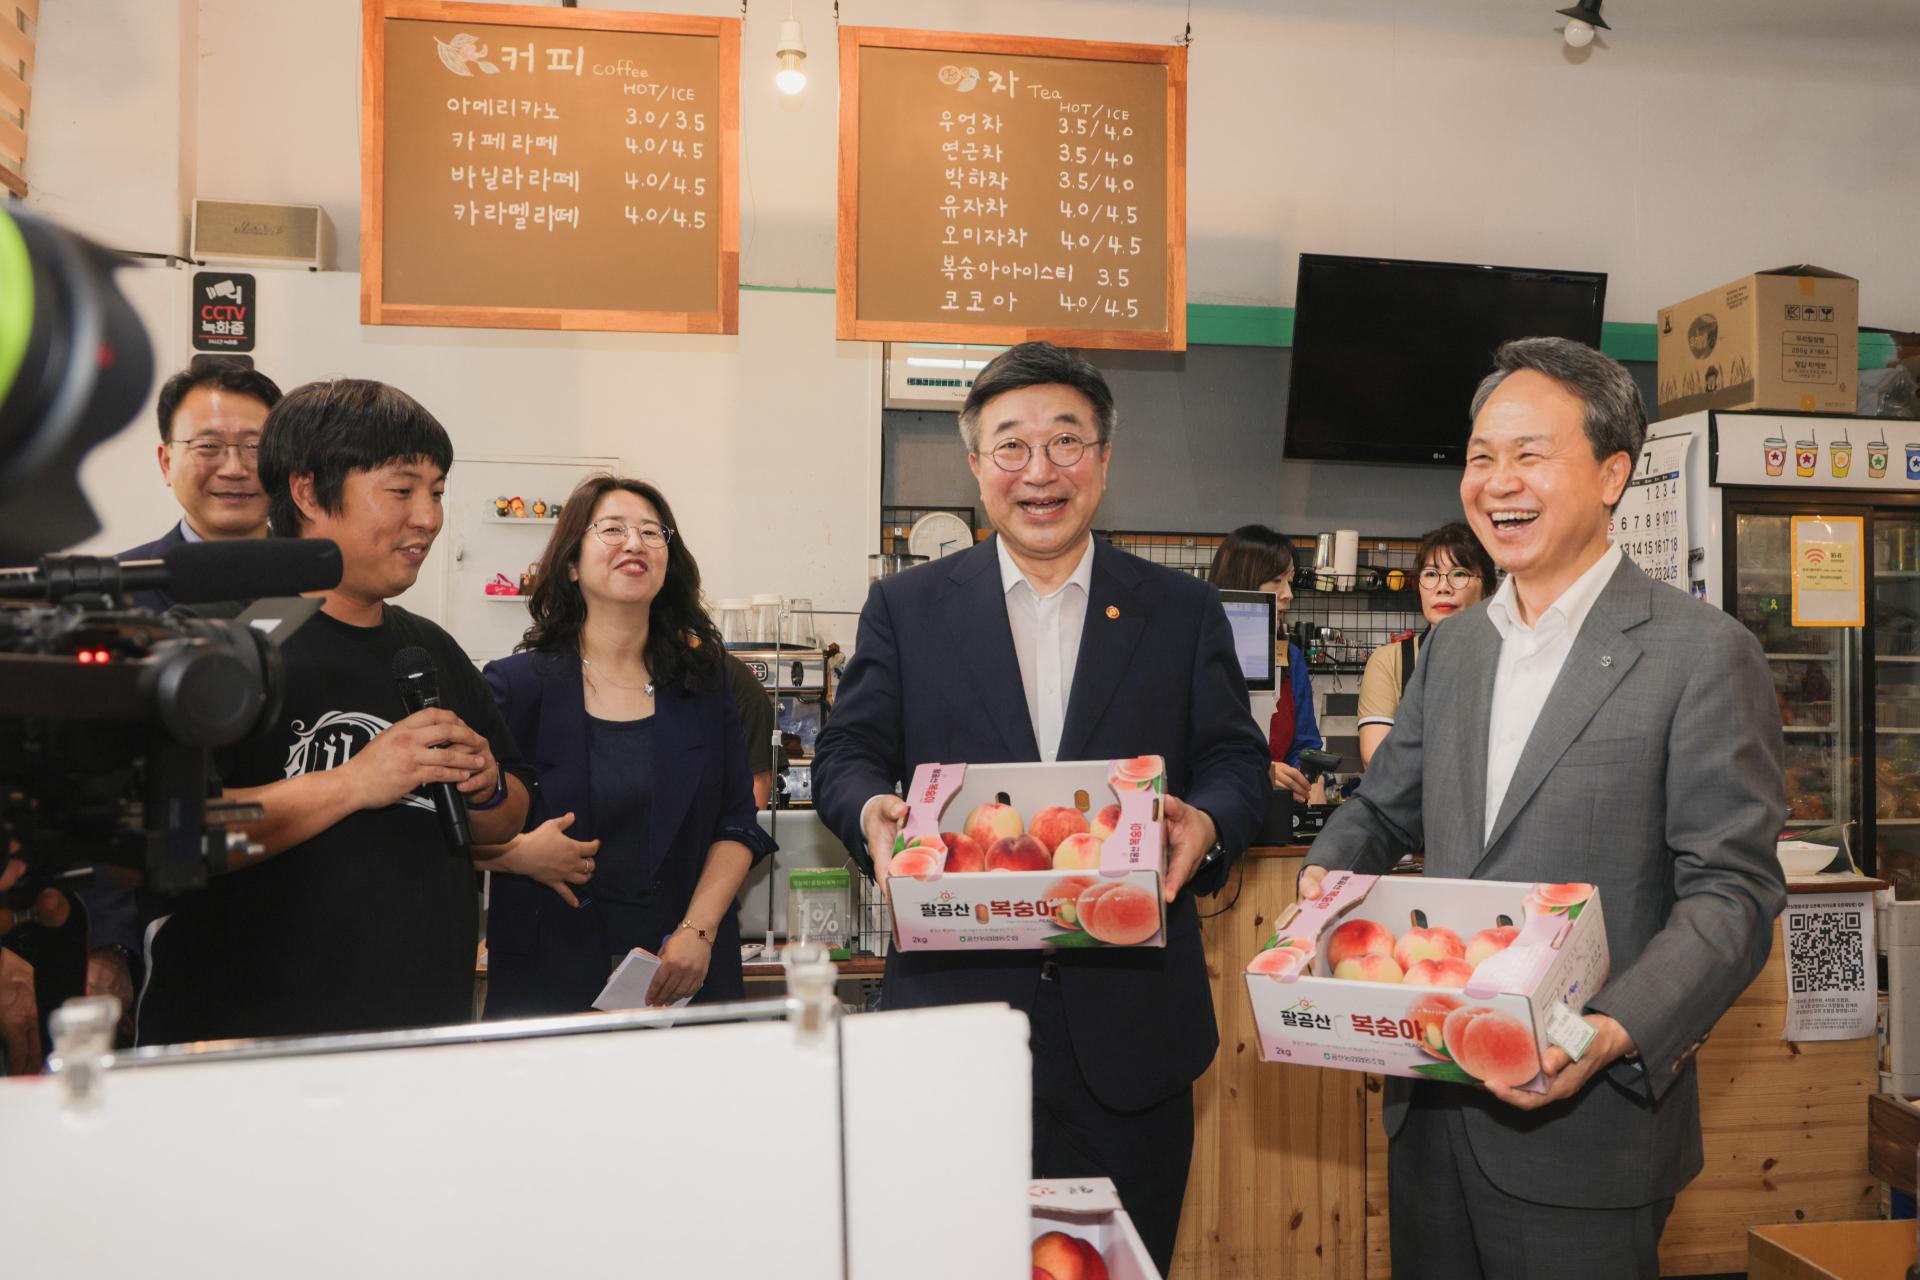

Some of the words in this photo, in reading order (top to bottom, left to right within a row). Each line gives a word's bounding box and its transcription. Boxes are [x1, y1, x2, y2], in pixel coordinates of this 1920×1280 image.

[502, 43, 584, 76] 커피
[988, 71, 1019, 98] 차
[1027, 85, 1062, 99] Tea
[448, 98, 559, 119] 아메리카노
[940, 111, 1002, 134] 우엉차
[942, 141, 1002, 162] 연근차
[946, 167, 1008, 190] 박하차
[940, 195, 1008, 218] 유자차
[942, 226, 1027, 247] 오미자차
[941, 255, 1073, 282] 복숭아아이스티
[1097, 269, 1129, 287] 3.5
[941, 291, 1017, 312] 코코아
[201, 305, 246, 320] CCTV
[202, 320, 245, 336] 녹화중
[1644, 452, 1652, 475] 7
[1646, 487, 1650, 500] 1
[1655, 485, 1660, 499] 2
[1663, 483, 1668, 497] 3
[1671, 481, 1676, 495] 4
[1608, 518, 1615, 532] 5
[1621, 517, 1627, 530] 6
[1634, 515, 1639, 529] 7
[1646, 514, 1651, 528] 8
[1656, 512, 1661, 526] 9
[1662, 510, 1669, 525] 10
[1670, 510, 1677, 524] 11
[1632, 541, 1642, 556] 14
[1644, 541, 1653, 555] 15
[1654, 539, 1662, 554] 16
[1662, 538, 1669, 553] 17
[1670, 536, 1677, 552] 18
[1663, 566, 1670, 580] 24
[1671, 565, 1678, 580] 25
[1129, 823, 1142, 846] 복숭아
[920, 903, 970, 918] 팔공산
[912, 936, 929, 944] 2kg
[1280, 1010, 1332, 1030] 팔공산
[1351, 1013, 1424, 1041] 복숭아
[1275, 1046, 1293, 1057] 2kg
